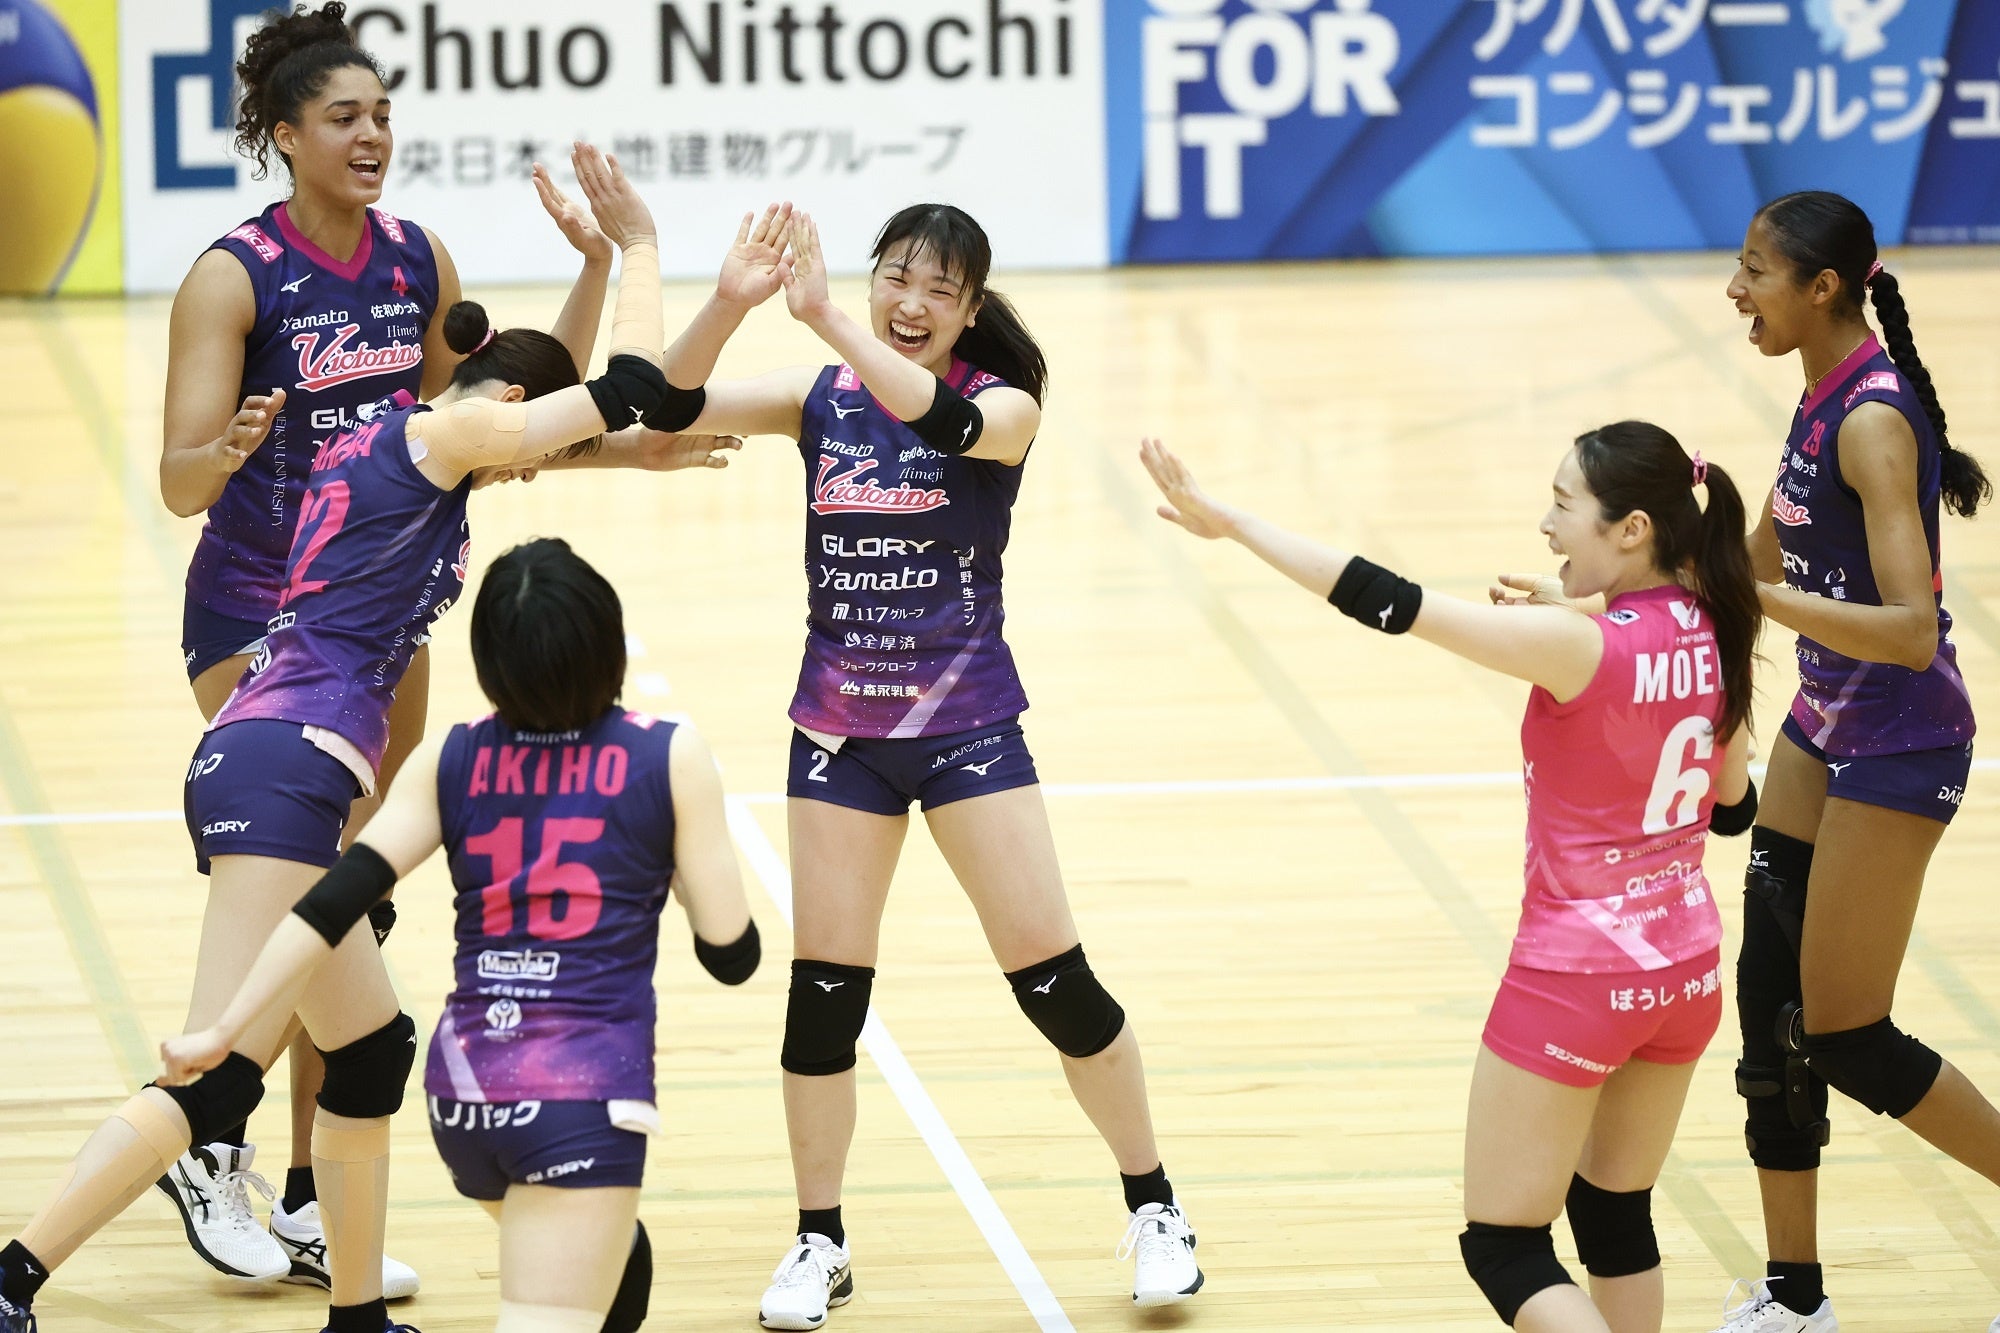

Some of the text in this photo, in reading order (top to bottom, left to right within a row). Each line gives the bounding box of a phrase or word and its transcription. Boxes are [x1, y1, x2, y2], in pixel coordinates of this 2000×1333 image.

[349, 0, 1072, 93] Chuo Nittochi
[1143, 11, 1401, 118] FOR
[1143, 114, 1267, 219] IT
[391, 266, 409, 297] 4
[279, 309, 349, 333] Yamato
[820, 434, 875, 458] amato
[1801, 418, 1826, 458] 29
[271, 453, 287, 529] UNIVERSITY
[810, 454, 951, 516] Victorina
[898, 466, 944, 483] Himeji
[821, 534, 936, 558] GLORY
[818, 564, 939, 592] Yamato
[860, 633, 917, 651] 全厚済
[862, 683, 920, 698] 森永乳業
[1633, 645, 1724, 704] MOE
[468, 744, 629, 797] AKIHO
[807, 749, 830, 783] 2
[1641, 714, 1715, 836] 6
[1937, 785, 1963, 807] DAIC
[465, 816, 606, 942] 15
[1610, 965, 1722, 1011] ぼうしや薬
